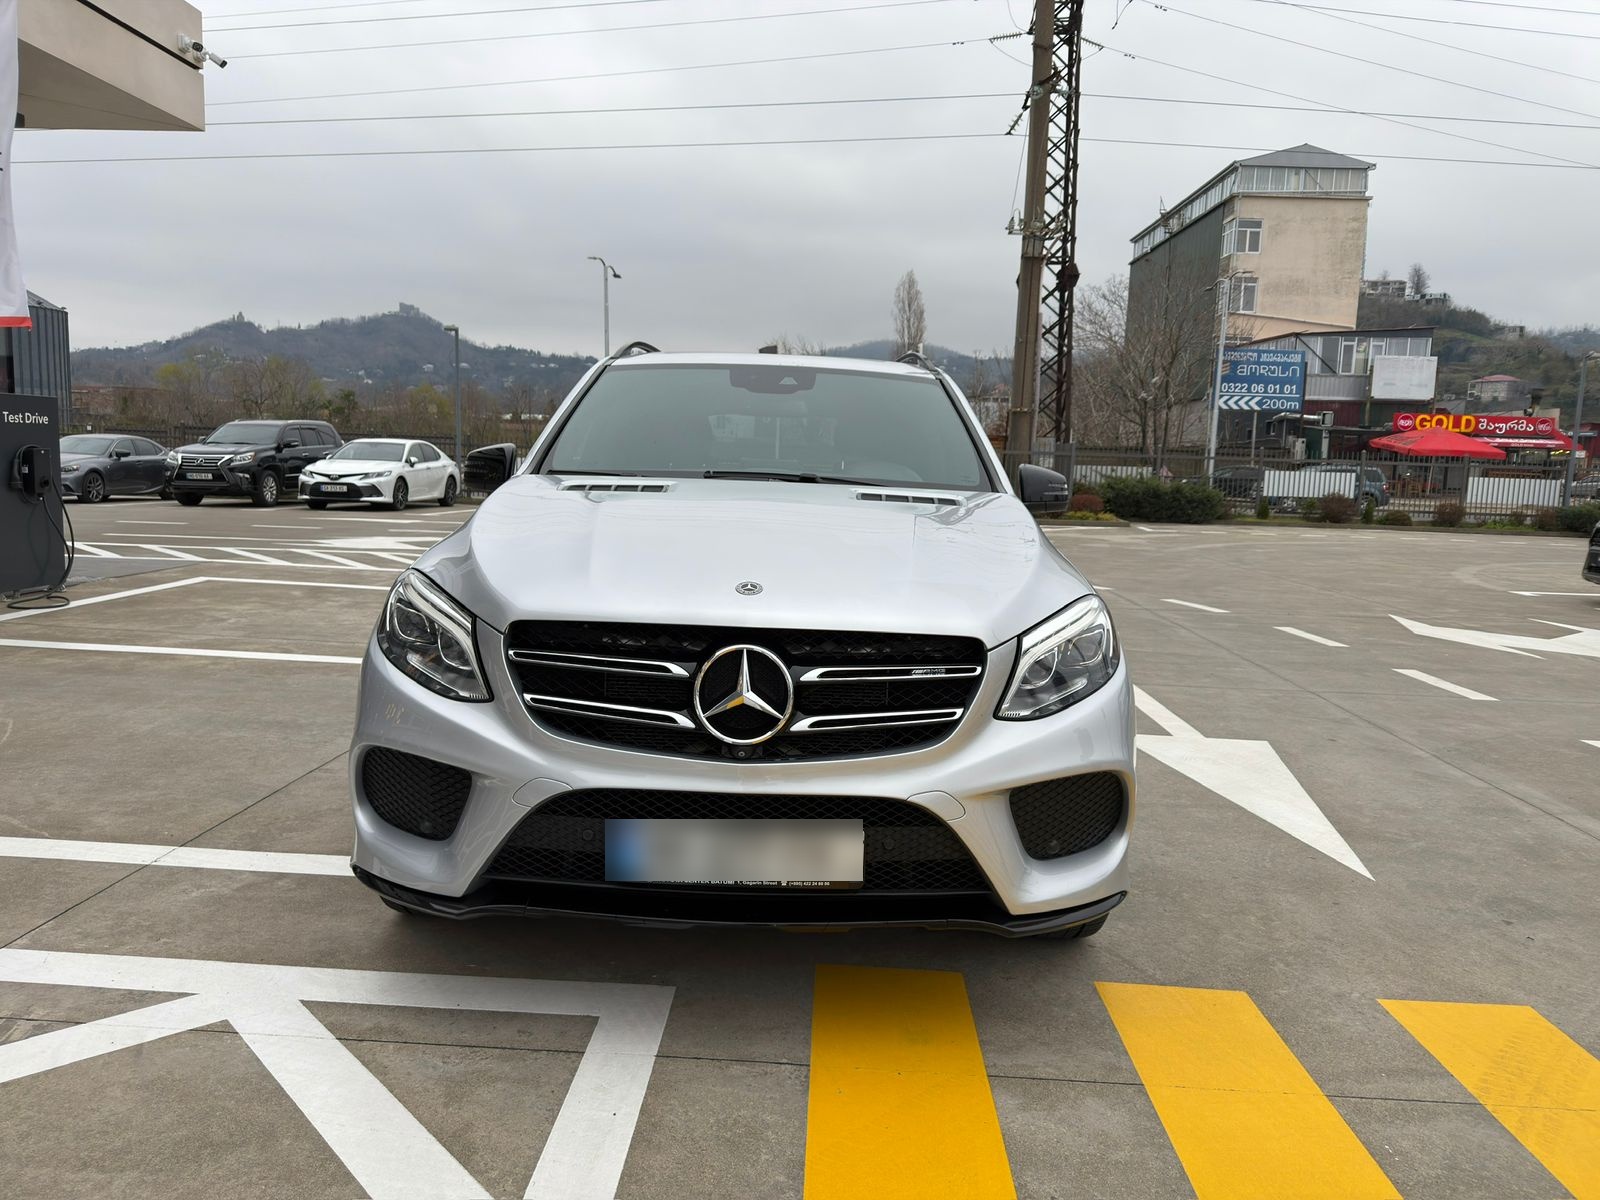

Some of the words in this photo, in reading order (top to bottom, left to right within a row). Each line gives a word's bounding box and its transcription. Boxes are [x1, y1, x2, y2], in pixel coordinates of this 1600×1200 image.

[1221, 383, 1248, 392] 0322
[1251, 383, 1264, 393] 06
[1267, 384, 1280, 393] 01
[1284, 384, 1297, 394] 01
[1262, 399, 1299, 410] 200m
[2, 411, 24, 423] Test
[25, 412, 49, 424] Drive
[1416, 414, 1476, 433] GOLD
[1479, 418, 1534, 434] შაურმა
